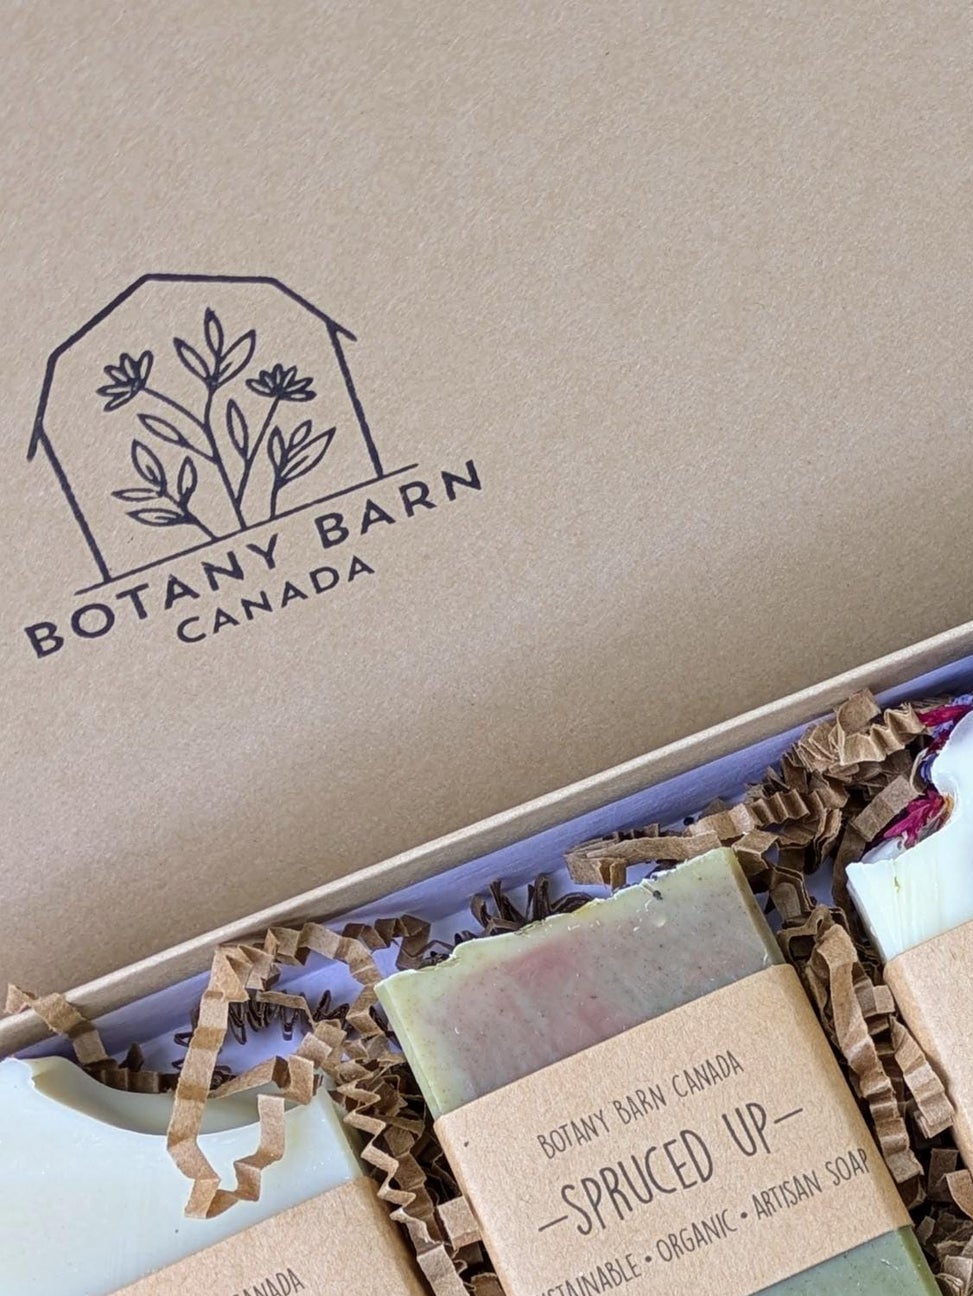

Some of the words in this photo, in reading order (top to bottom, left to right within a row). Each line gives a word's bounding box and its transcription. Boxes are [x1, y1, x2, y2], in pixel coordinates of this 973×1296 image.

[24, 534, 279, 658] BOTANY
[315, 459, 482, 549] BARN
[176, 556, 375, 643] CANADA
[537, 1110, 610, 1159] BOTANY
[613, 1084, 666, 1125] BARN
[672, 1050, 744, 1098] CANADA
[656, 1209, 738, 1263] ORGANIC
[751, 1170, 822, 1220] ARTISAN
[825, 1148, 870, 1186] SOAP
